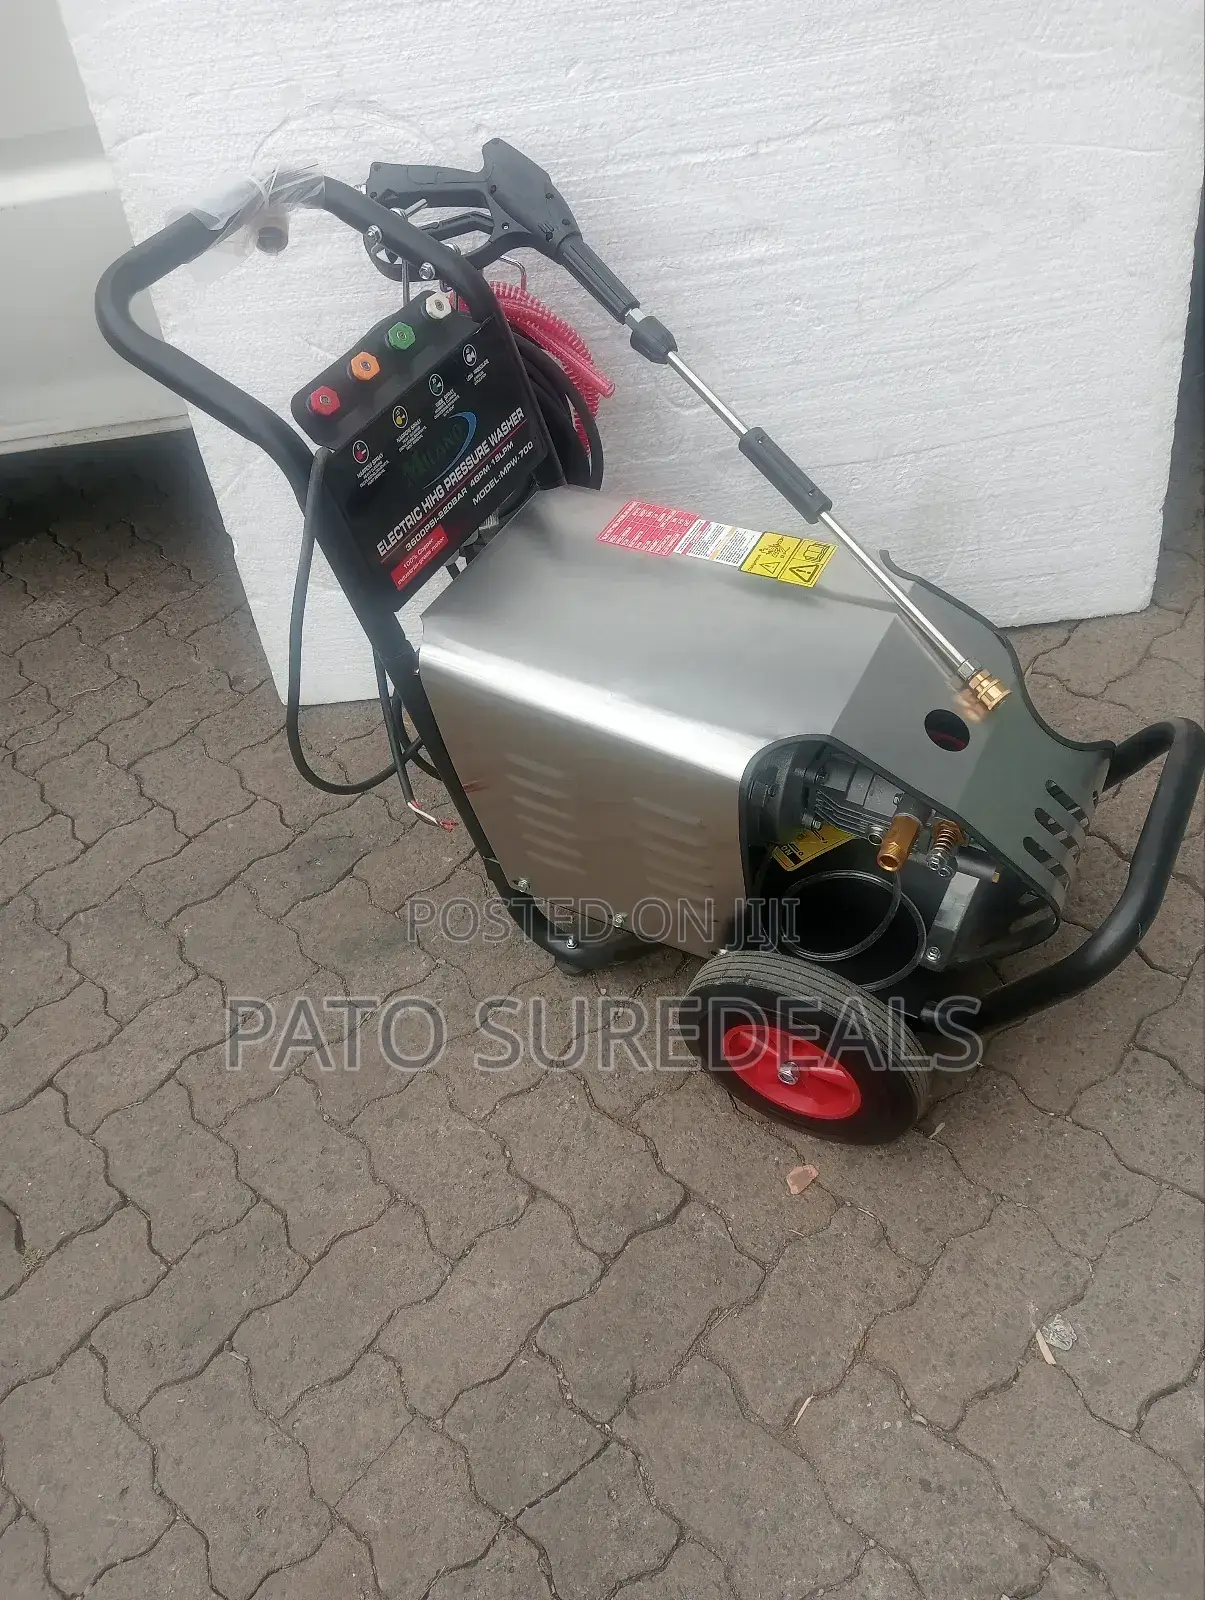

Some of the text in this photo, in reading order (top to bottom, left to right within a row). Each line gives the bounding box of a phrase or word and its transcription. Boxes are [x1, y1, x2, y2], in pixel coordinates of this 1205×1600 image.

[376, 506, 423, 557] ELECTRIC
[420, 484, 445, 513] HIHG
[443, 439, 490, 491] PRESSURE
[488, 407, 525, 447] WASHER
[403, 538, 434, 569] 100% Copper
